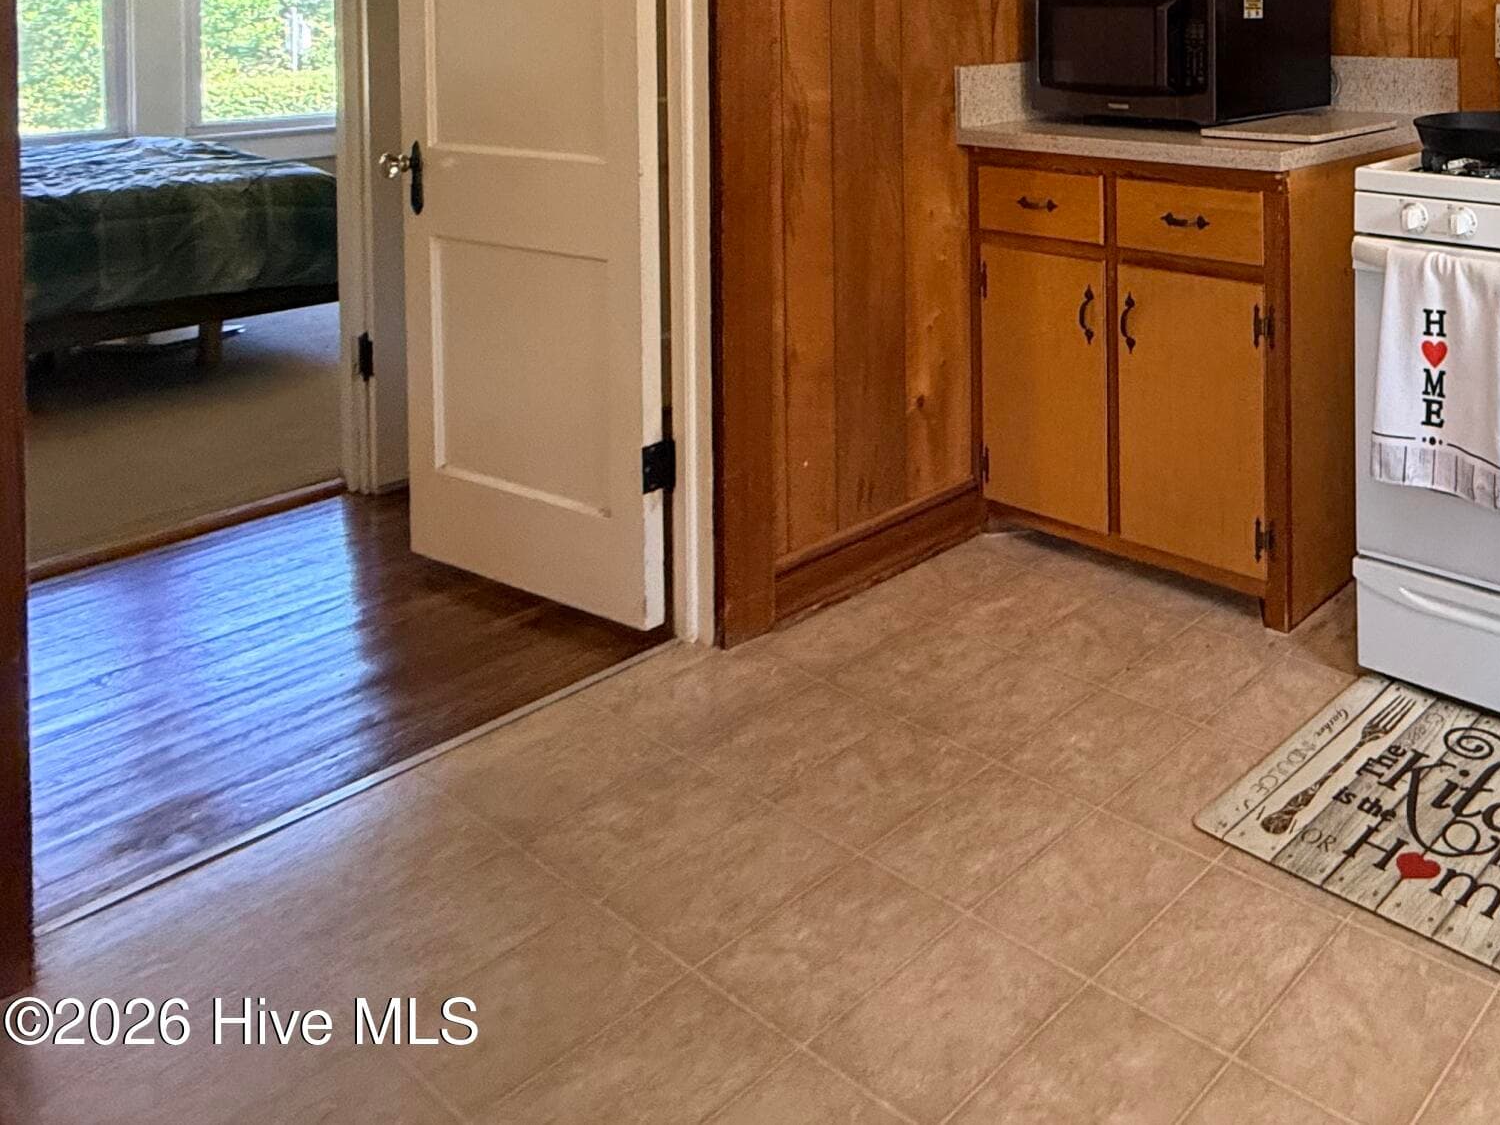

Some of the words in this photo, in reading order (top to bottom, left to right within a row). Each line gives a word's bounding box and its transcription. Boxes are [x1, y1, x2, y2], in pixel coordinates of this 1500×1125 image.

[1421, 309, 1448, 428] HME
[1356, 741, 1407, 779] The
[1332, 786, 1356, 805] is
[1357, 796, 1397, 822] the
